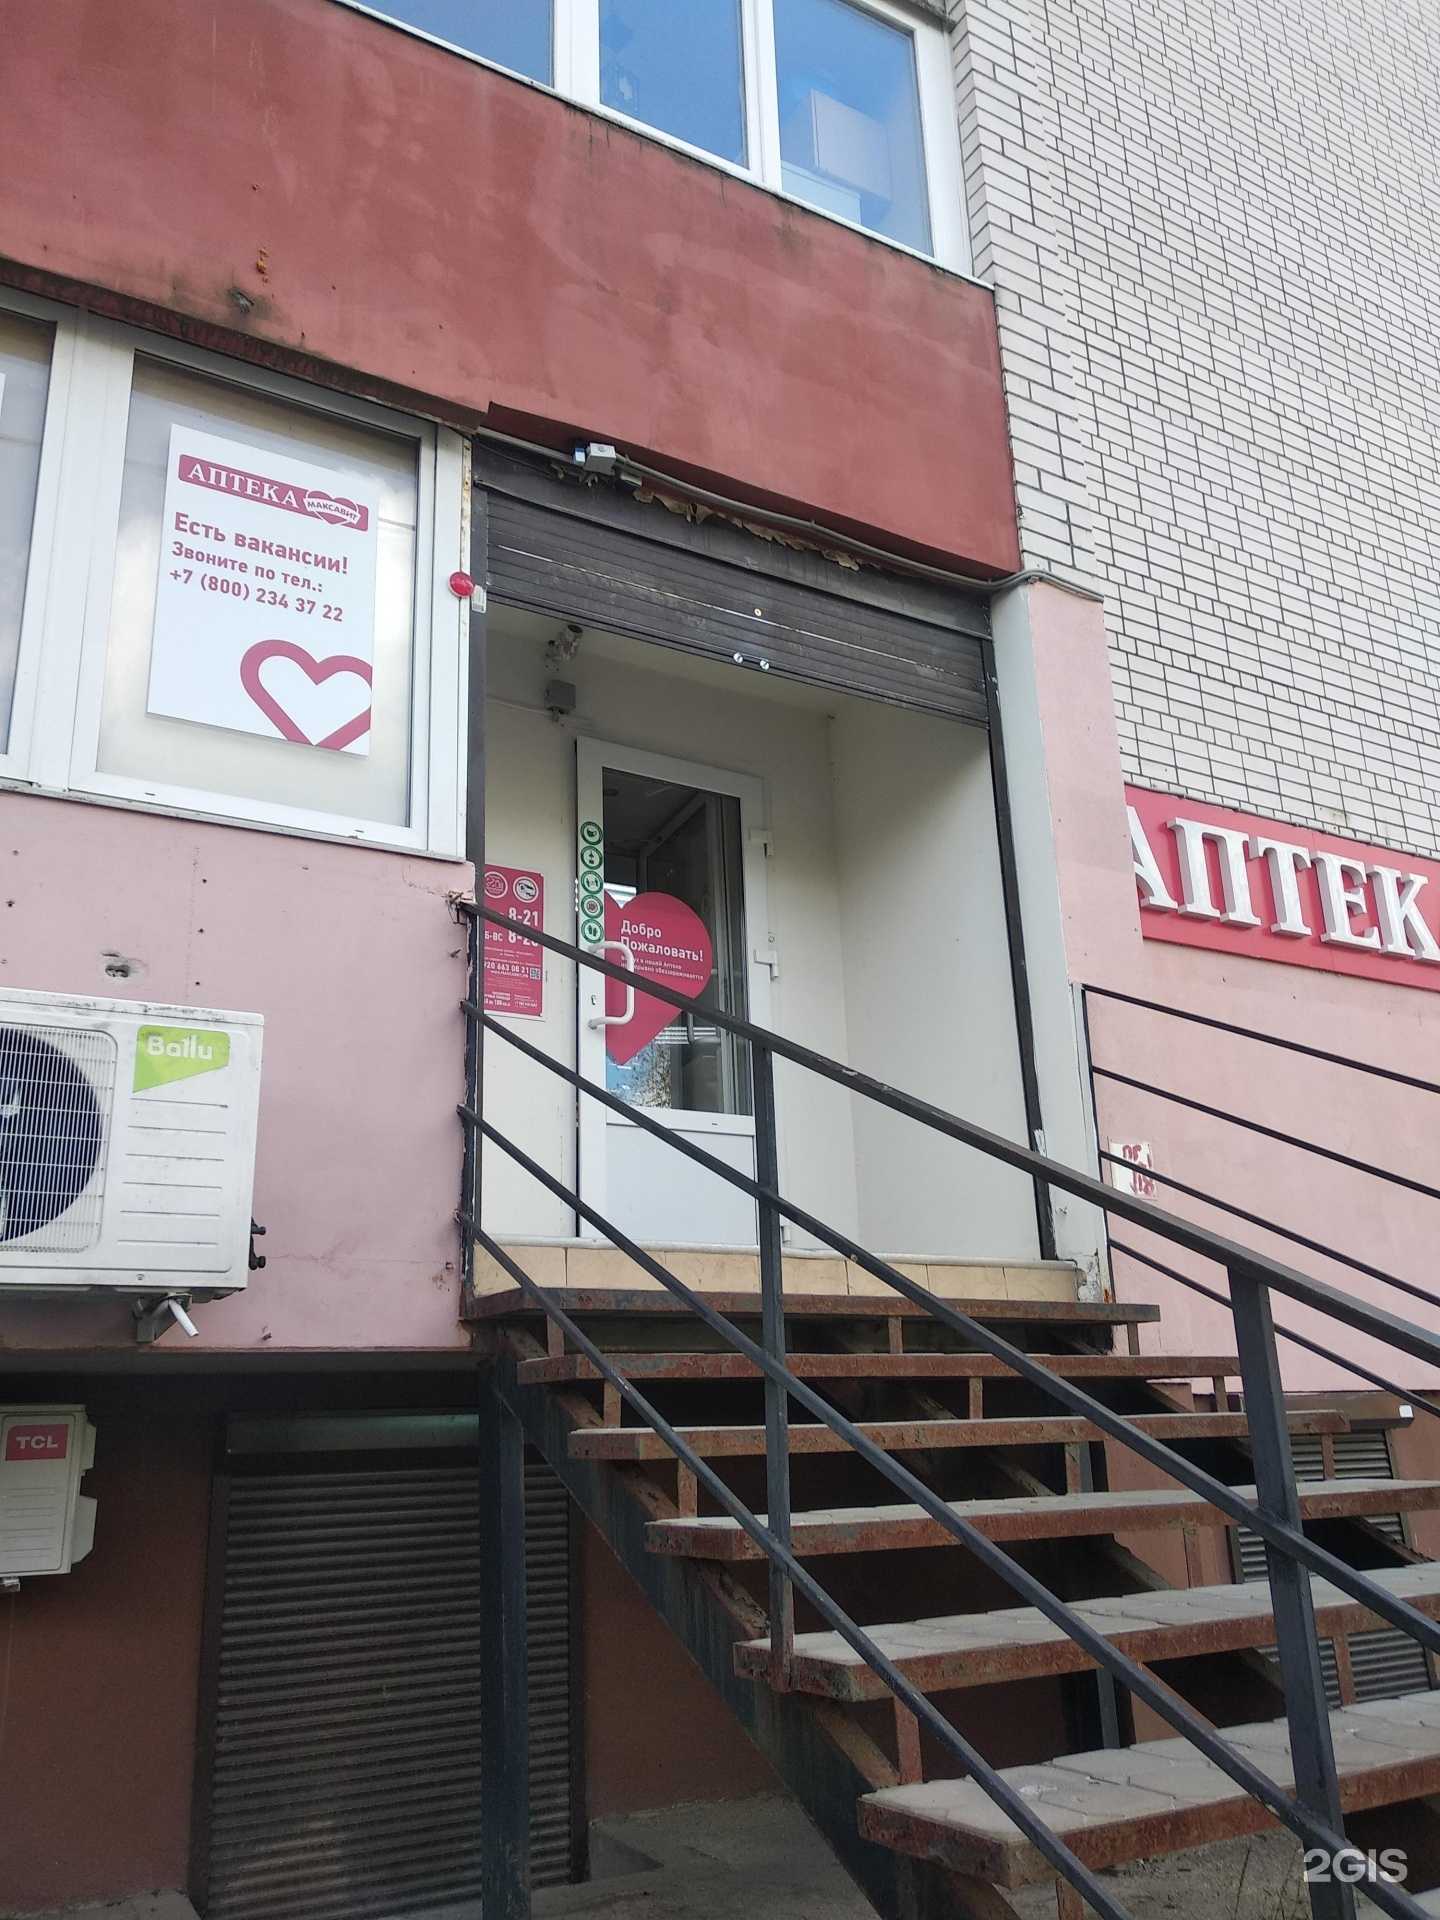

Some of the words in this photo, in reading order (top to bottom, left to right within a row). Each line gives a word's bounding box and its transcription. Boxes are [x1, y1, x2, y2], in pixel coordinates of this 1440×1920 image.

[188, 463, 300, 508] АПТЕКА
[307, 501, 359, 521] МАКСАВИТ
[174, 511, 226, 542] Есть
[234, 532, 348, 575] вакансии!
[172, 541, 249, 573] Звоните
[255, 565, 276, 580] по
[281, 571, 323, 593] тел.:
[169, 568, 194, 584] +7
[200, 573, 250, 601] (800)
[256, 587, 289, 609] 234
[295, 597, 316, 615] 37
[322, 604, 343, 622] 22
[508, 906, 539, 927] 8-21
[620, 919, 662, 939] Добро
[620, 936, 704, 962] Пожаловать!
[146, 1034, 213, 1060] Ballu
[15, 1435, 59, 1450] TCL
